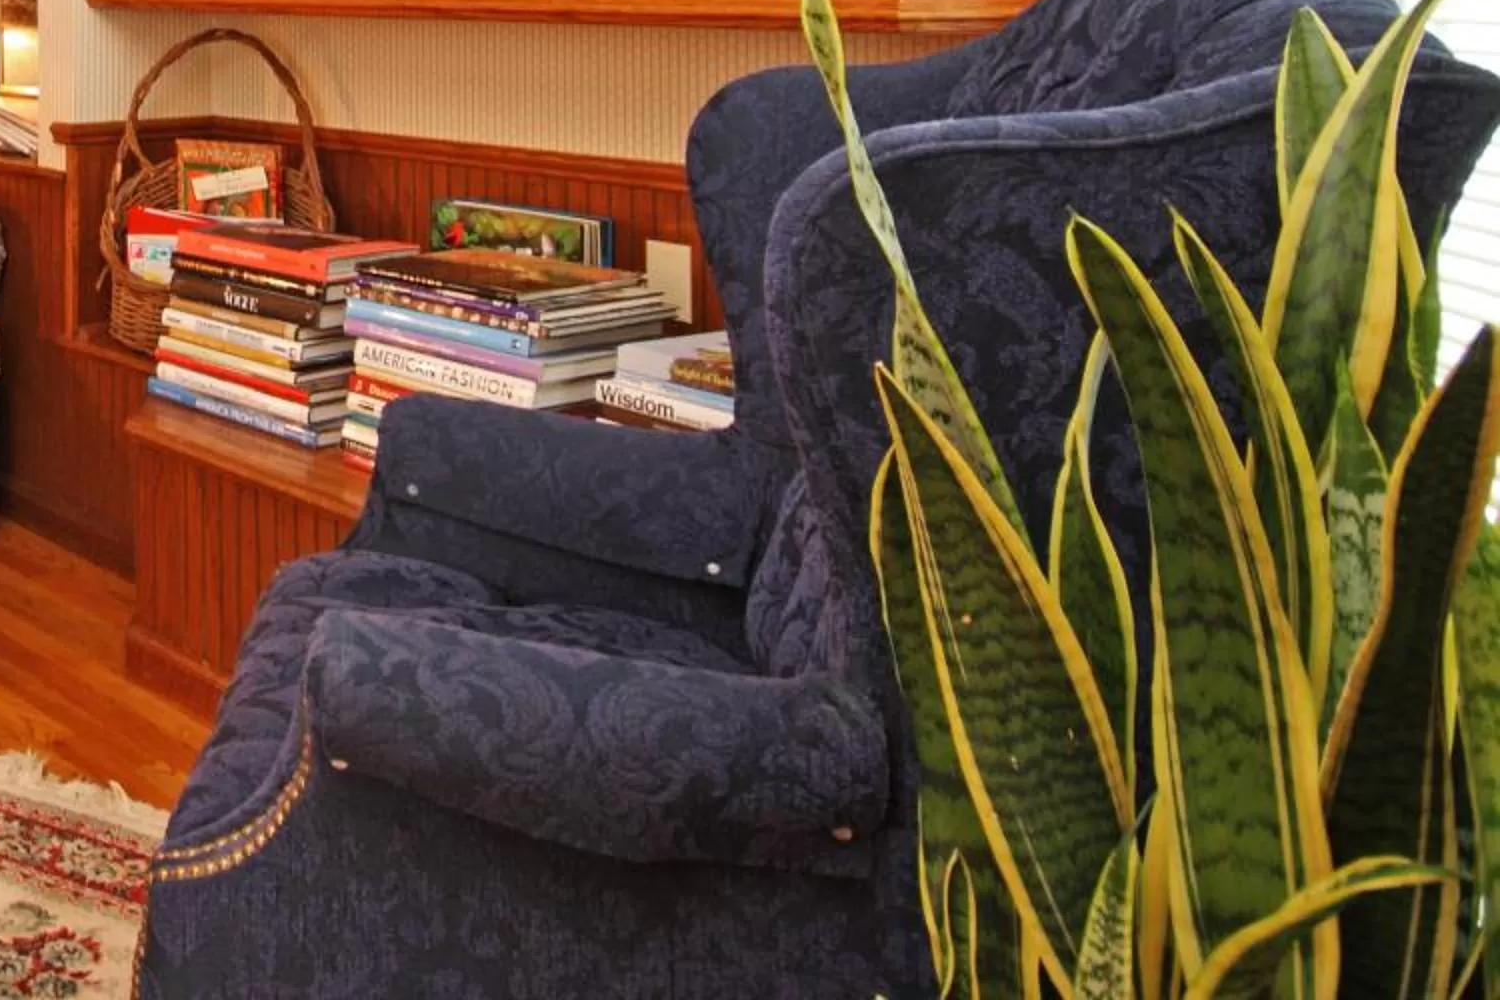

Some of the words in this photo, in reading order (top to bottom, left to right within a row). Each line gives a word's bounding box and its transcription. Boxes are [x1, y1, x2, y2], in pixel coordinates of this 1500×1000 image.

[361, 345, 436, 380] AMERICAN
[441, 366, 514, 400] FASHION
[600, 383, 675, 418] Wisdom
